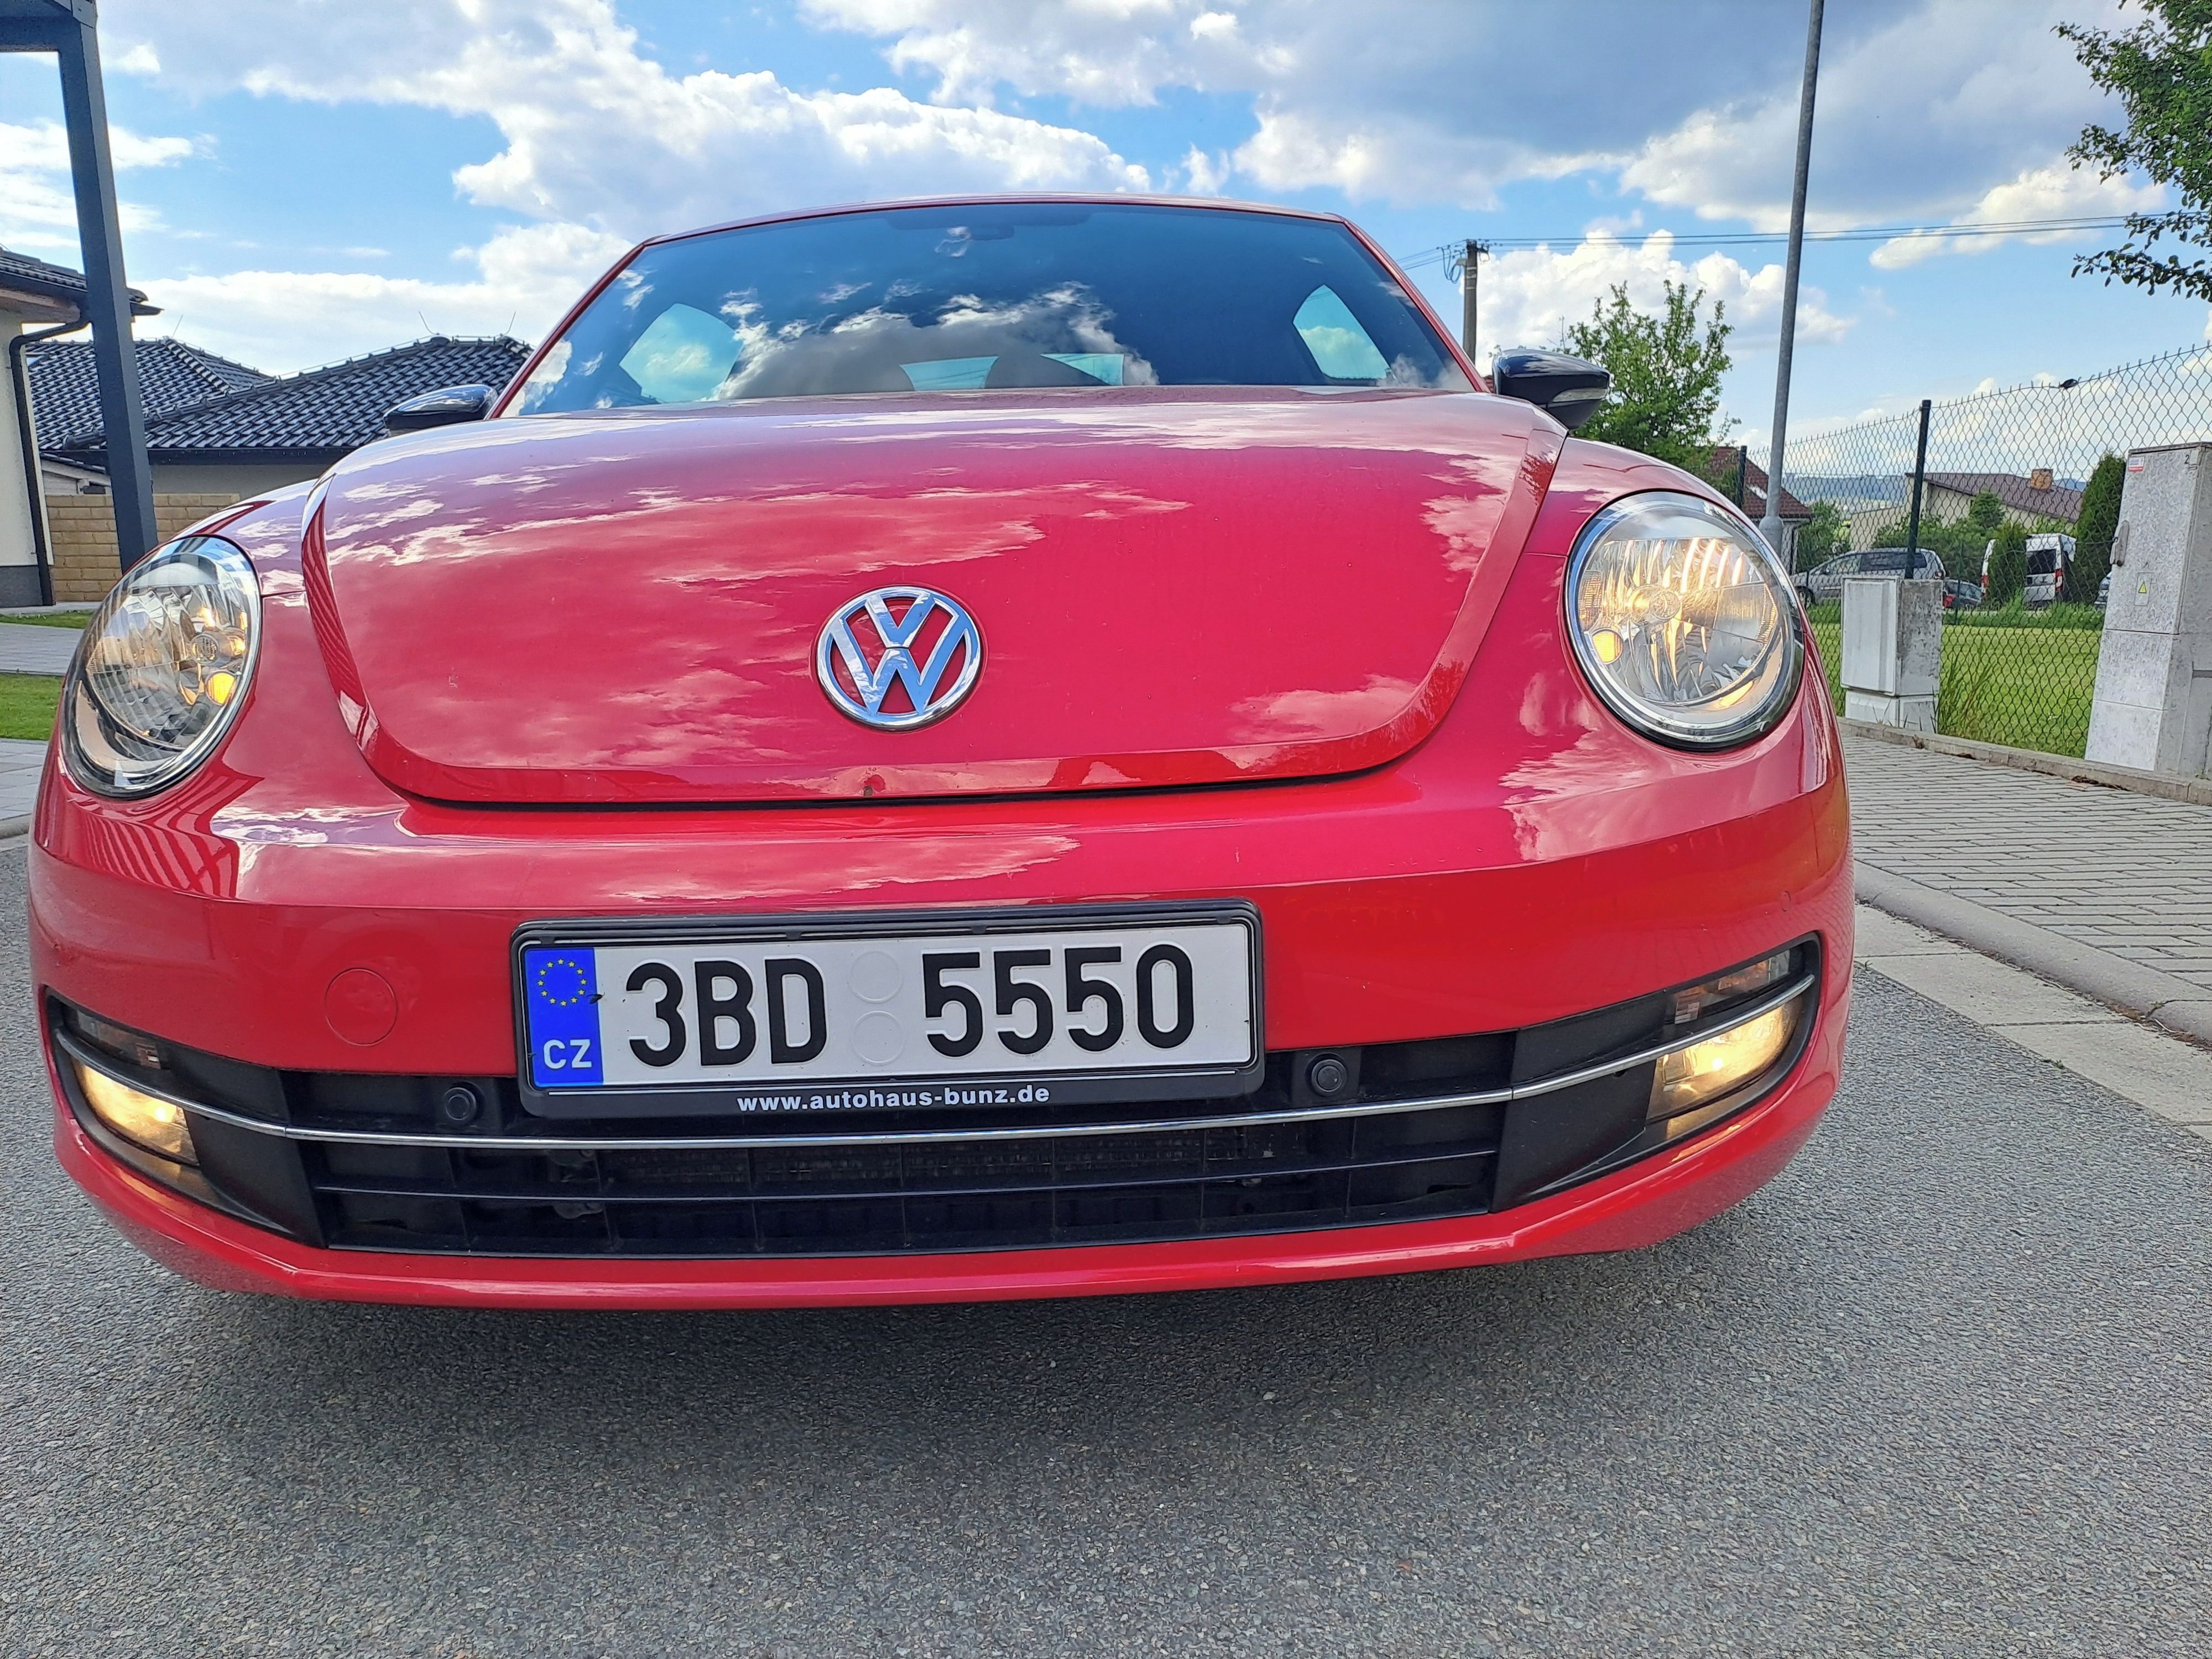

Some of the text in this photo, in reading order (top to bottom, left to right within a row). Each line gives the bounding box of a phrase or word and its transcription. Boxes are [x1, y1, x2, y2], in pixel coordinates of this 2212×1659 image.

[625, 943, 1194, 1067] 3BD 5550
[544, 1039, 592, 1069] CZ
[737, 1084, 1050, 1112] www.autohaus-bunz.de
